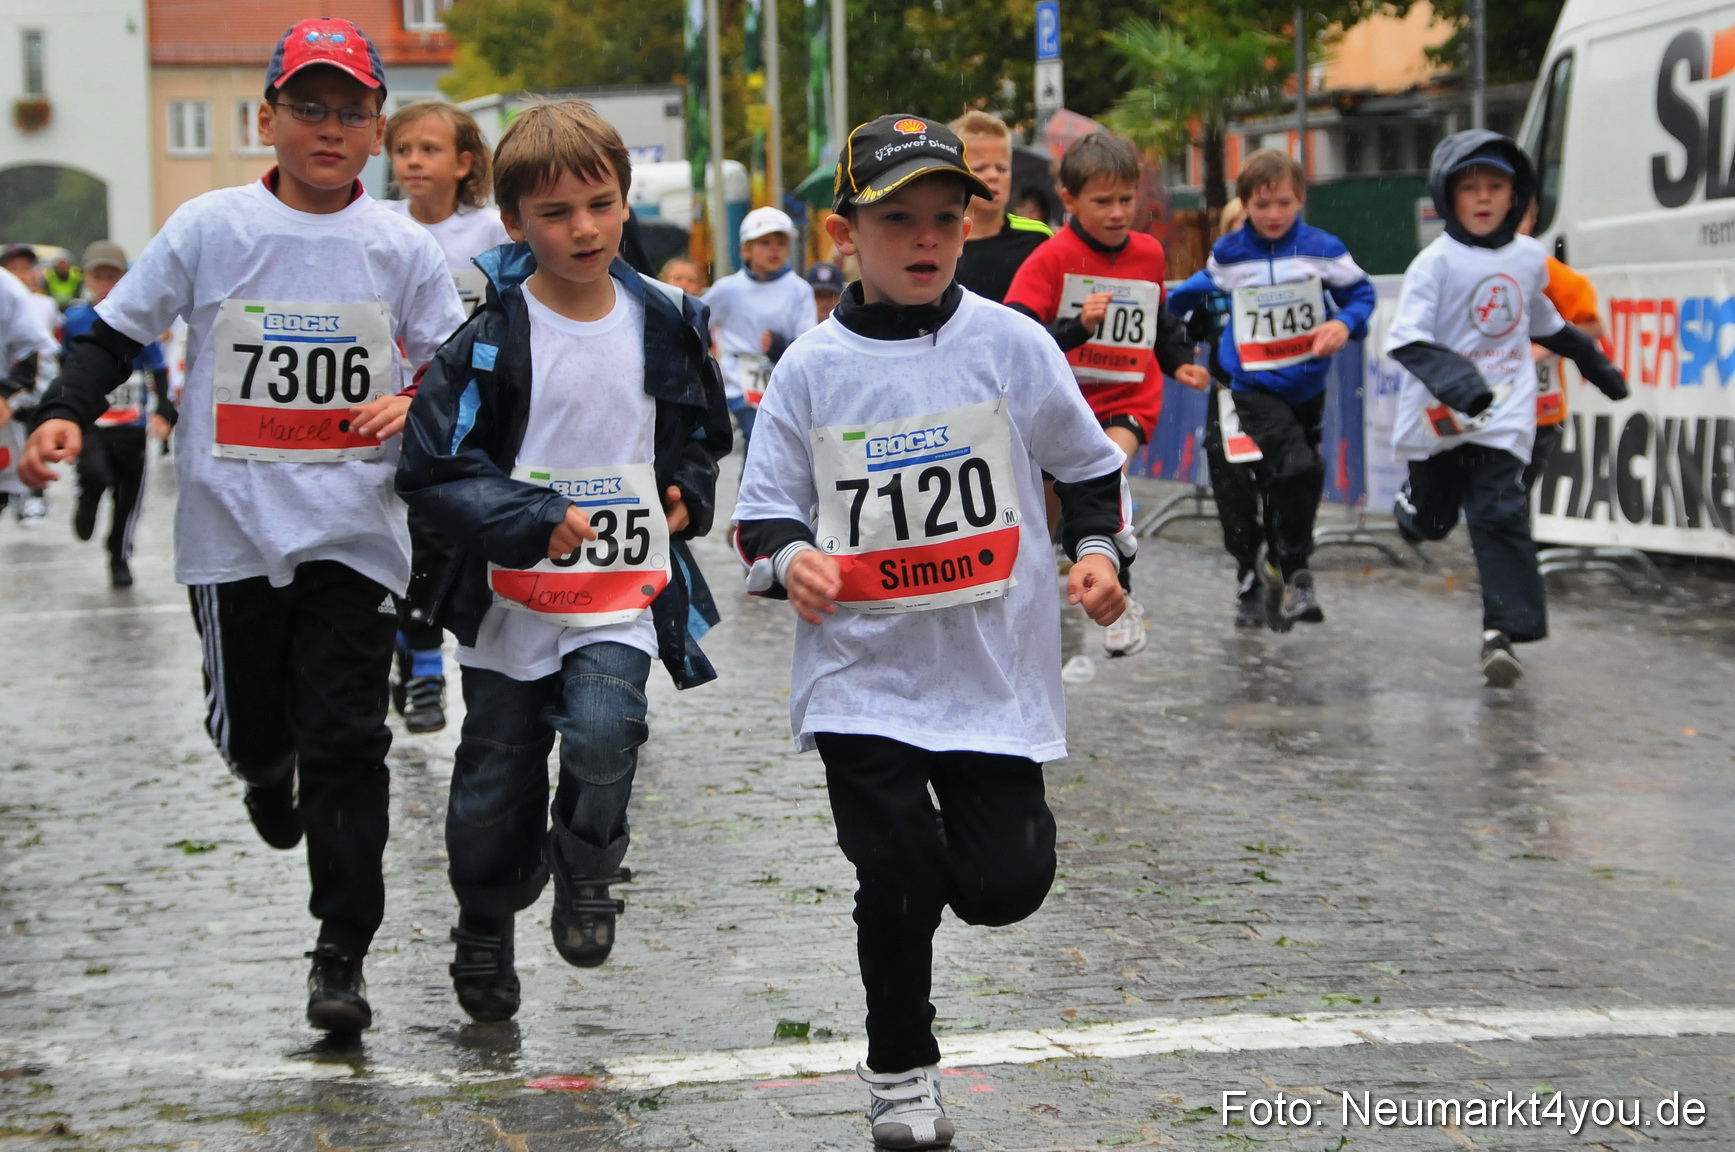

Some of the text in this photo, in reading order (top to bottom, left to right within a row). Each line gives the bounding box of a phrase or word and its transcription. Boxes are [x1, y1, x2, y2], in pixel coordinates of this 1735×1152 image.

[875, 140, 958, 161] V-Power Diesel
[263, 313, 340, 333] BOCK
[1246, 303, 1315, 338] 7143
[232, 343, 371, 405] 7306
[258, 415, 333, 443] Marcel
[866, 426, 950, 459] BOCK
[550, 477, 622, 497] BOCK
[836, 457, 997, 548] 7120
[1004, 511, 1015, 524] M
[826, 539, 835, 551] 4
[879, 554, 974, 590] Simon
[517, 574, 593, 610] Jonas
